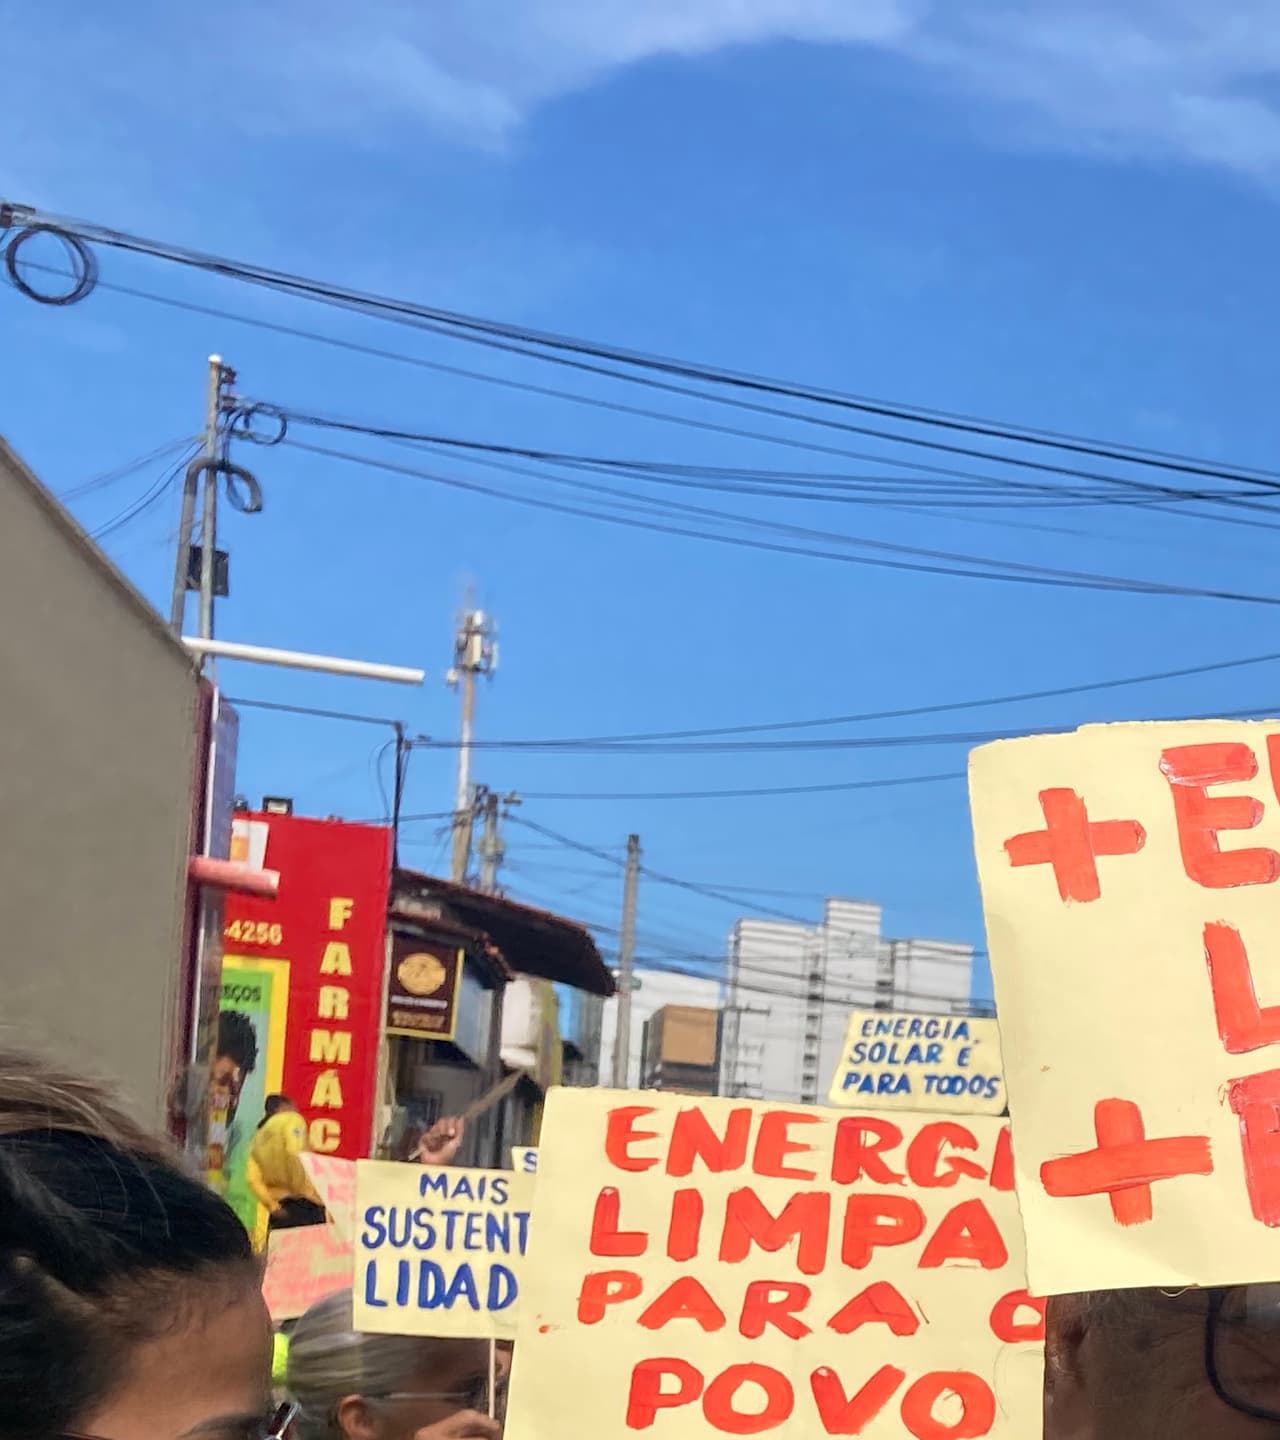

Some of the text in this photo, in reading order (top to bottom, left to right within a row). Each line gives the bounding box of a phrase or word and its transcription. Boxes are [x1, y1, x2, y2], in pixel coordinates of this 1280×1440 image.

[861, 1018, 970, 1041] ENERGIA
[849, 1042, 944, 1065] SOLAR
[842, 1072, 1001, 1099] PARA TODOS
[419, 1173, 509, 1205] MAIS
[589, 1186, 1009, 1275] LIMPA
[364, 1258, 519, 1312] LIDAD
[576, 1269, 923, 1340] PARA
